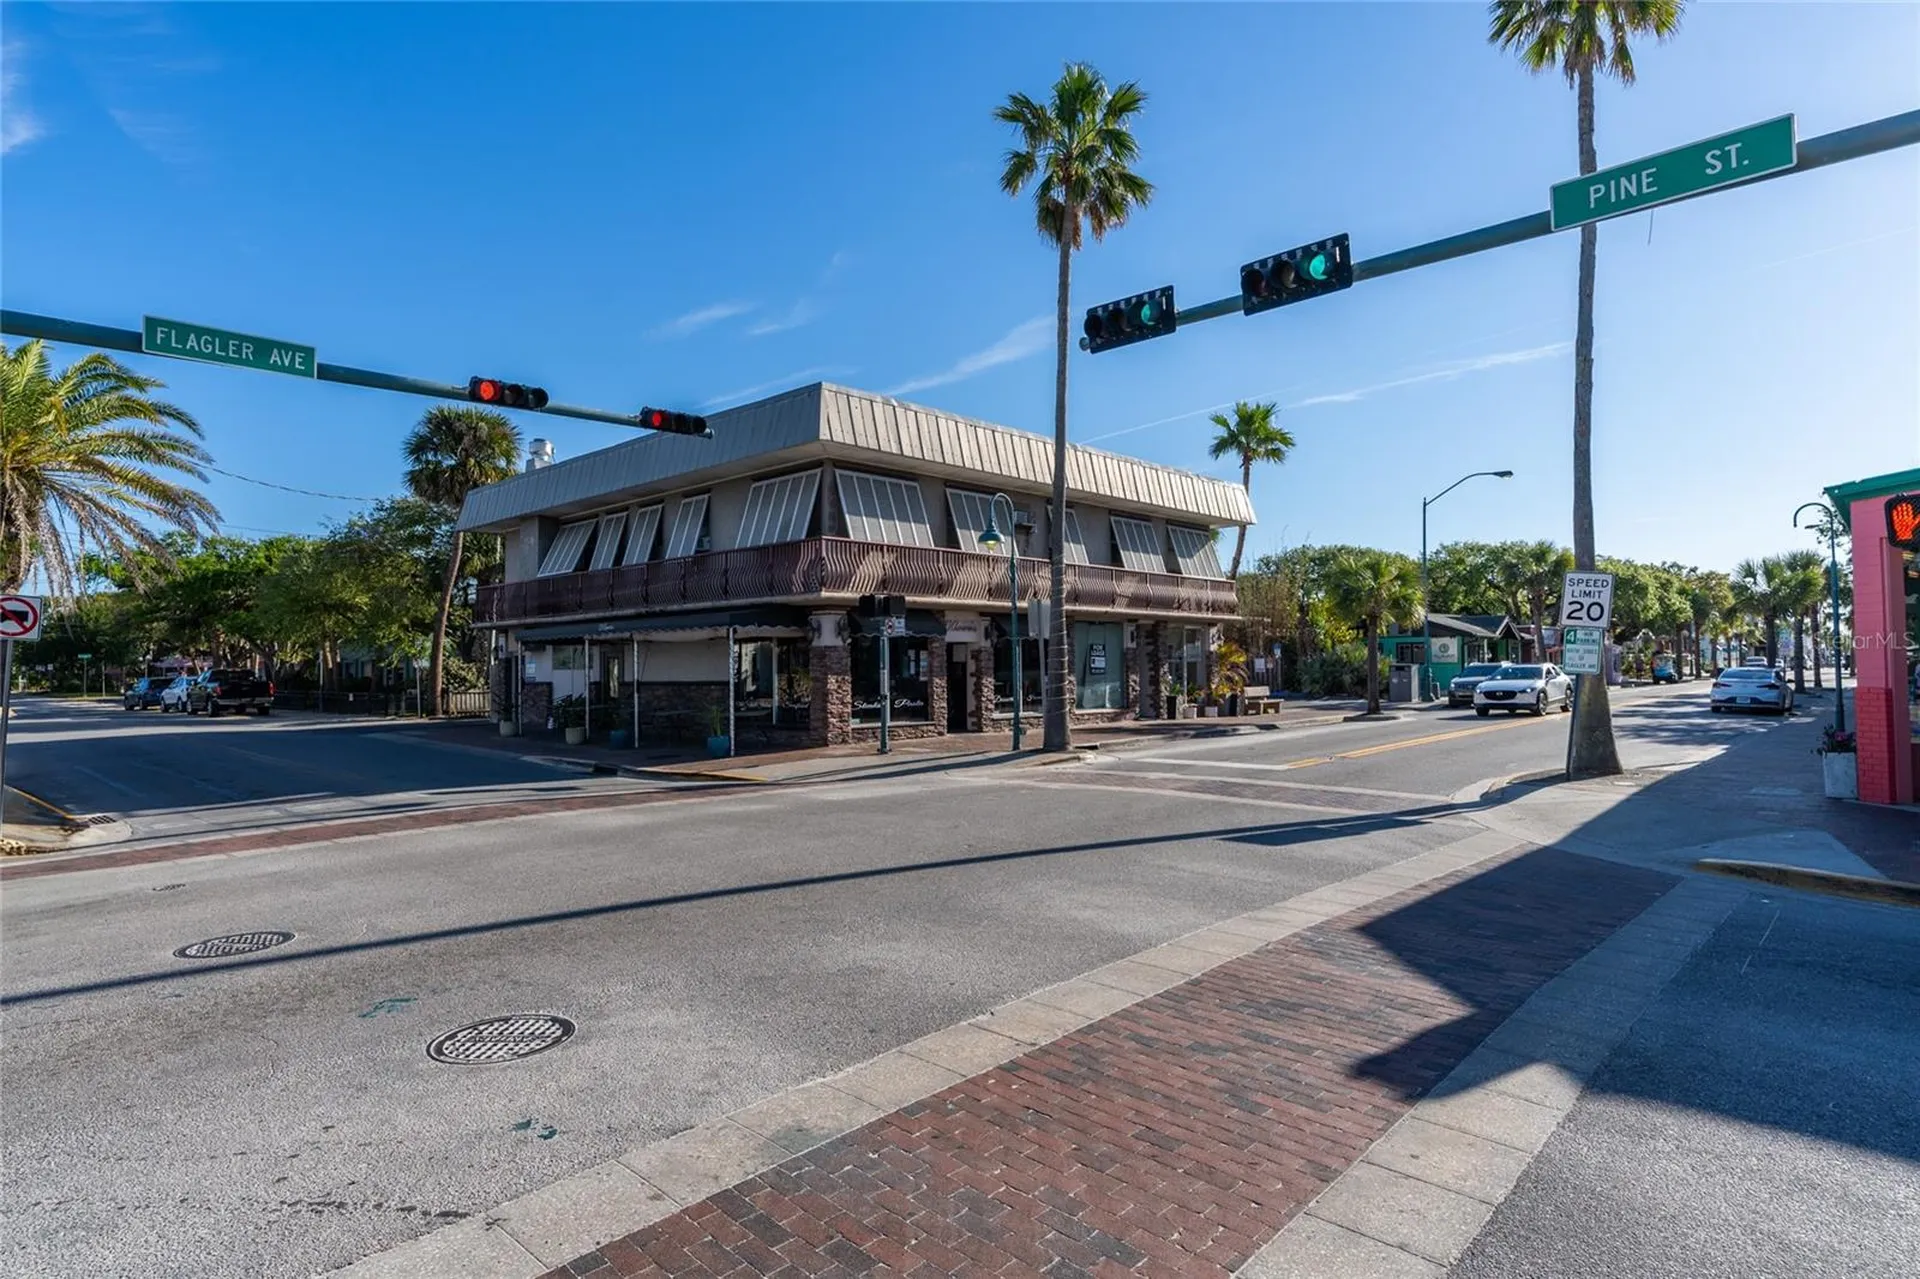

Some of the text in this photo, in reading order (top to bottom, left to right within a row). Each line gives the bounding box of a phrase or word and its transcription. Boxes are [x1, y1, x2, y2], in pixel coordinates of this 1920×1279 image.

[1589, 143, 1750, 209] PINE ST.
[156, 326, 306, 370] FLAGLER AVE
[1567, 577, 1610, 589] SPEED
[1571, 590, 1604, 599] LIMIT
[1565, 600, 1605, 622] 20
[1566, 630, 1575, 643] 4
